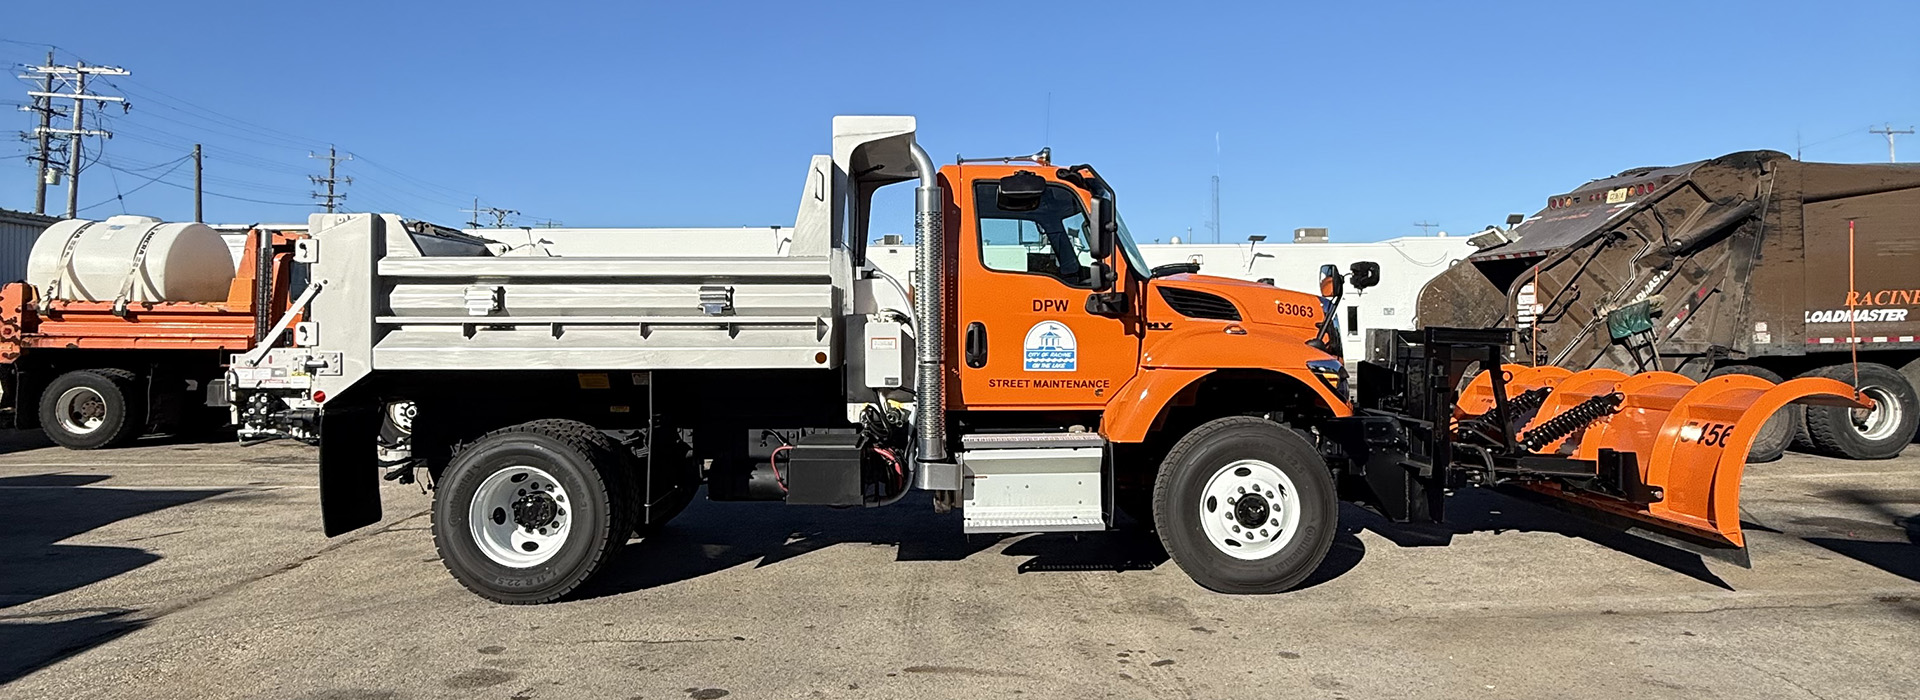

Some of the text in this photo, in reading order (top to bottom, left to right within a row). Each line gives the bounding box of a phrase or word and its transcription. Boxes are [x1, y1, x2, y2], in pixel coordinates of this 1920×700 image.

[1032, 299, 1069, 312] DPW
[1277, 302, 1314, 318] 63063
[1804, 308, 1908, 323] LOADMASTER
[988, 378, 1110, 389] STREET MAINTENANCE
